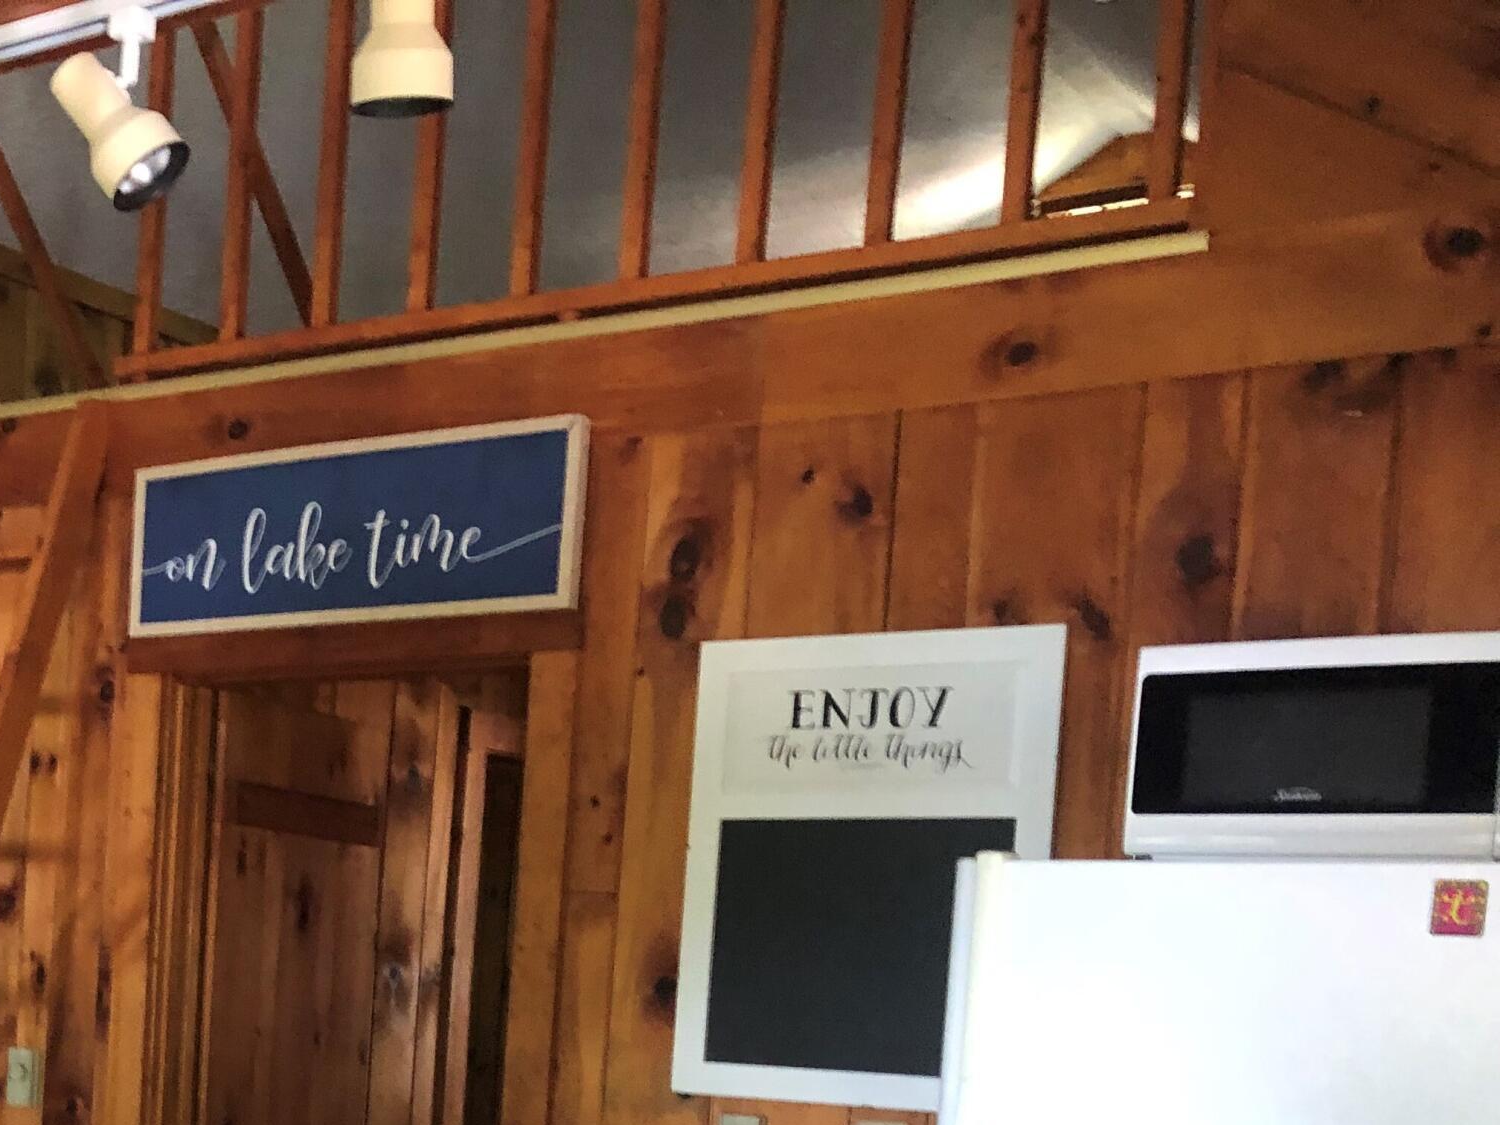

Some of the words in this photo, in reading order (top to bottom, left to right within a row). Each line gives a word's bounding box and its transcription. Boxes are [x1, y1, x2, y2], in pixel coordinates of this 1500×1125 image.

[160, 535, 226, 592] on
[241, 501, 353, 594] lake
[364, 507, 486, 590] time
[788, 686, 954, 730] ENJOY
